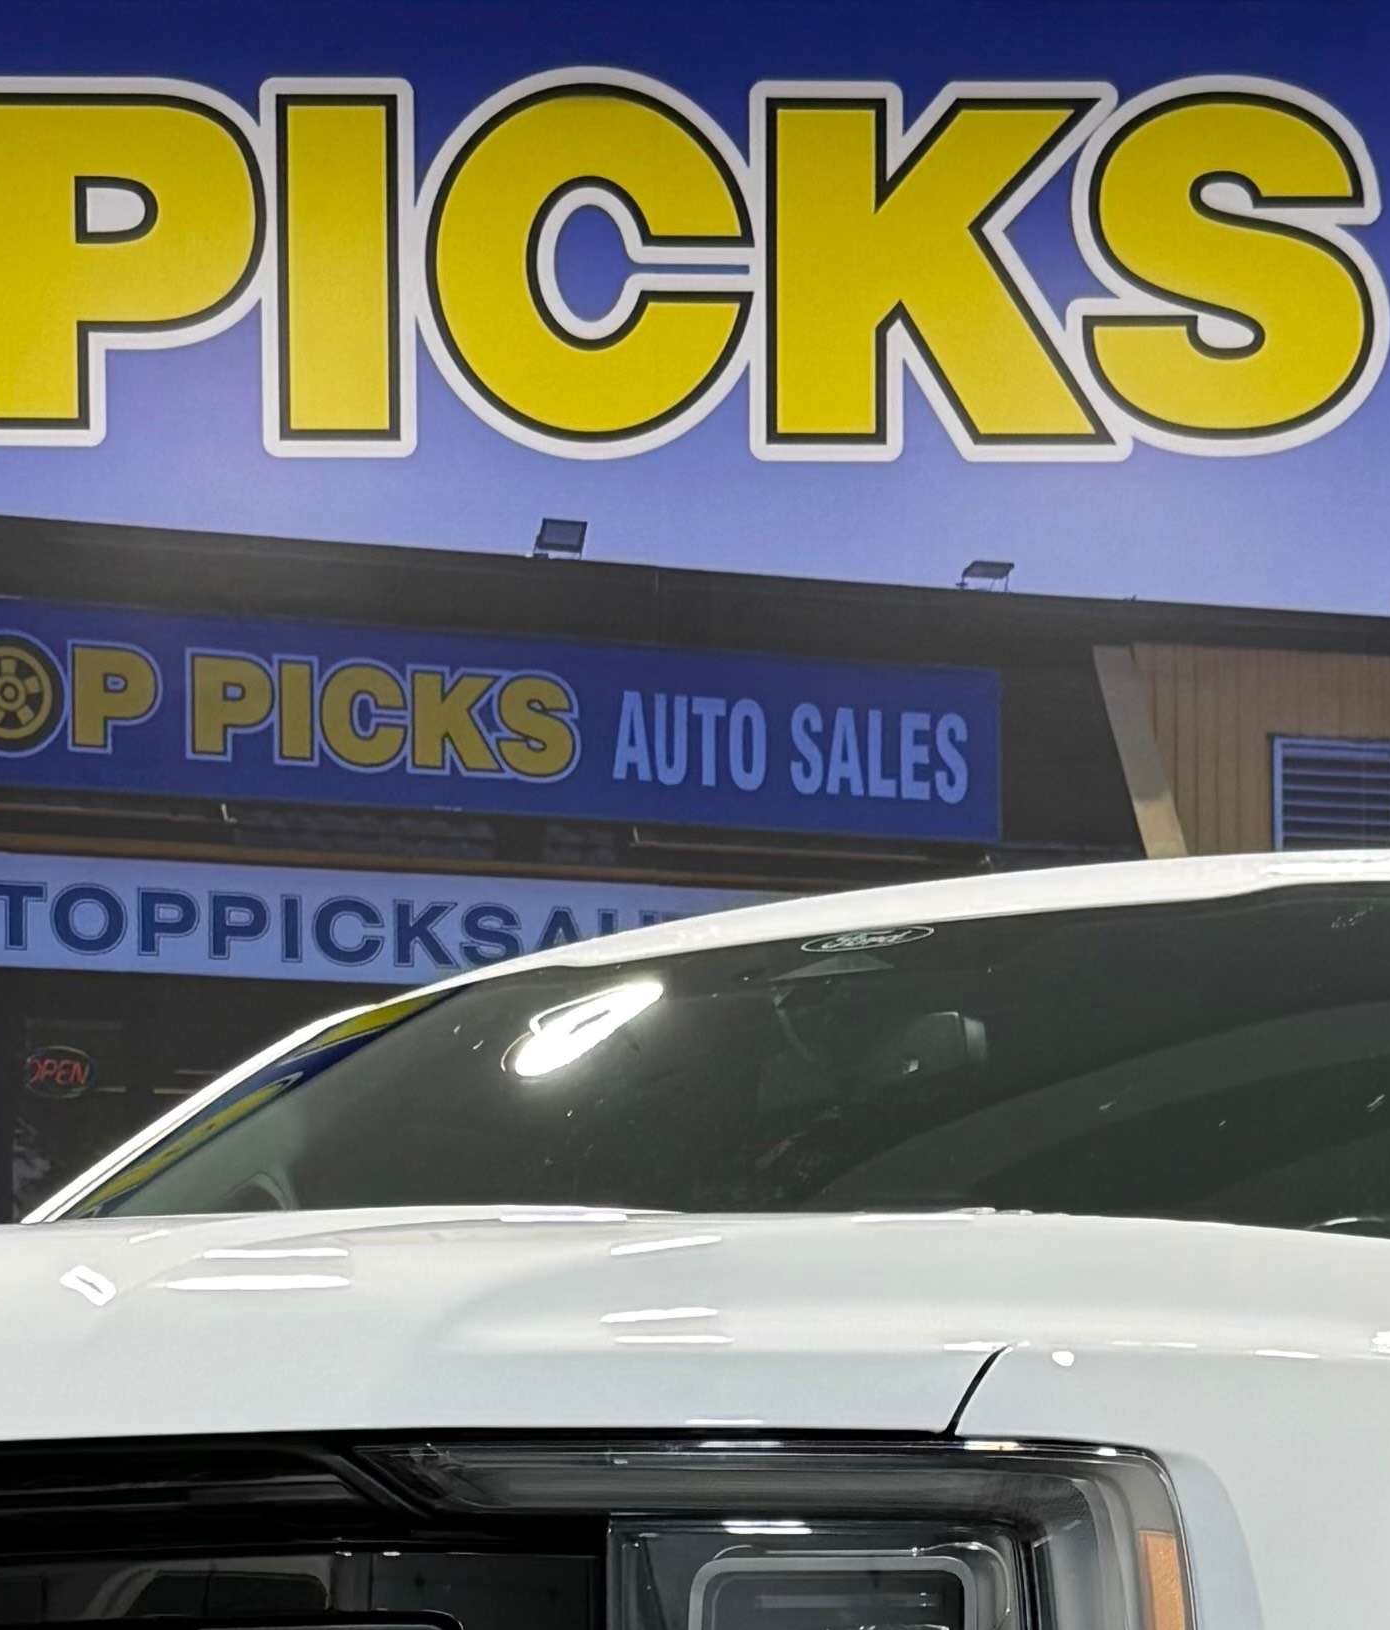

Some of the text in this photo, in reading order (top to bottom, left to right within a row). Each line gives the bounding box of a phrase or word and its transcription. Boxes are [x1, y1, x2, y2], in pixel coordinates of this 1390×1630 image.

[185, 647, 581, 784] PICKS
[613, 690, 767, 791] AUTO
[790, 703, 969, 804] SALES
